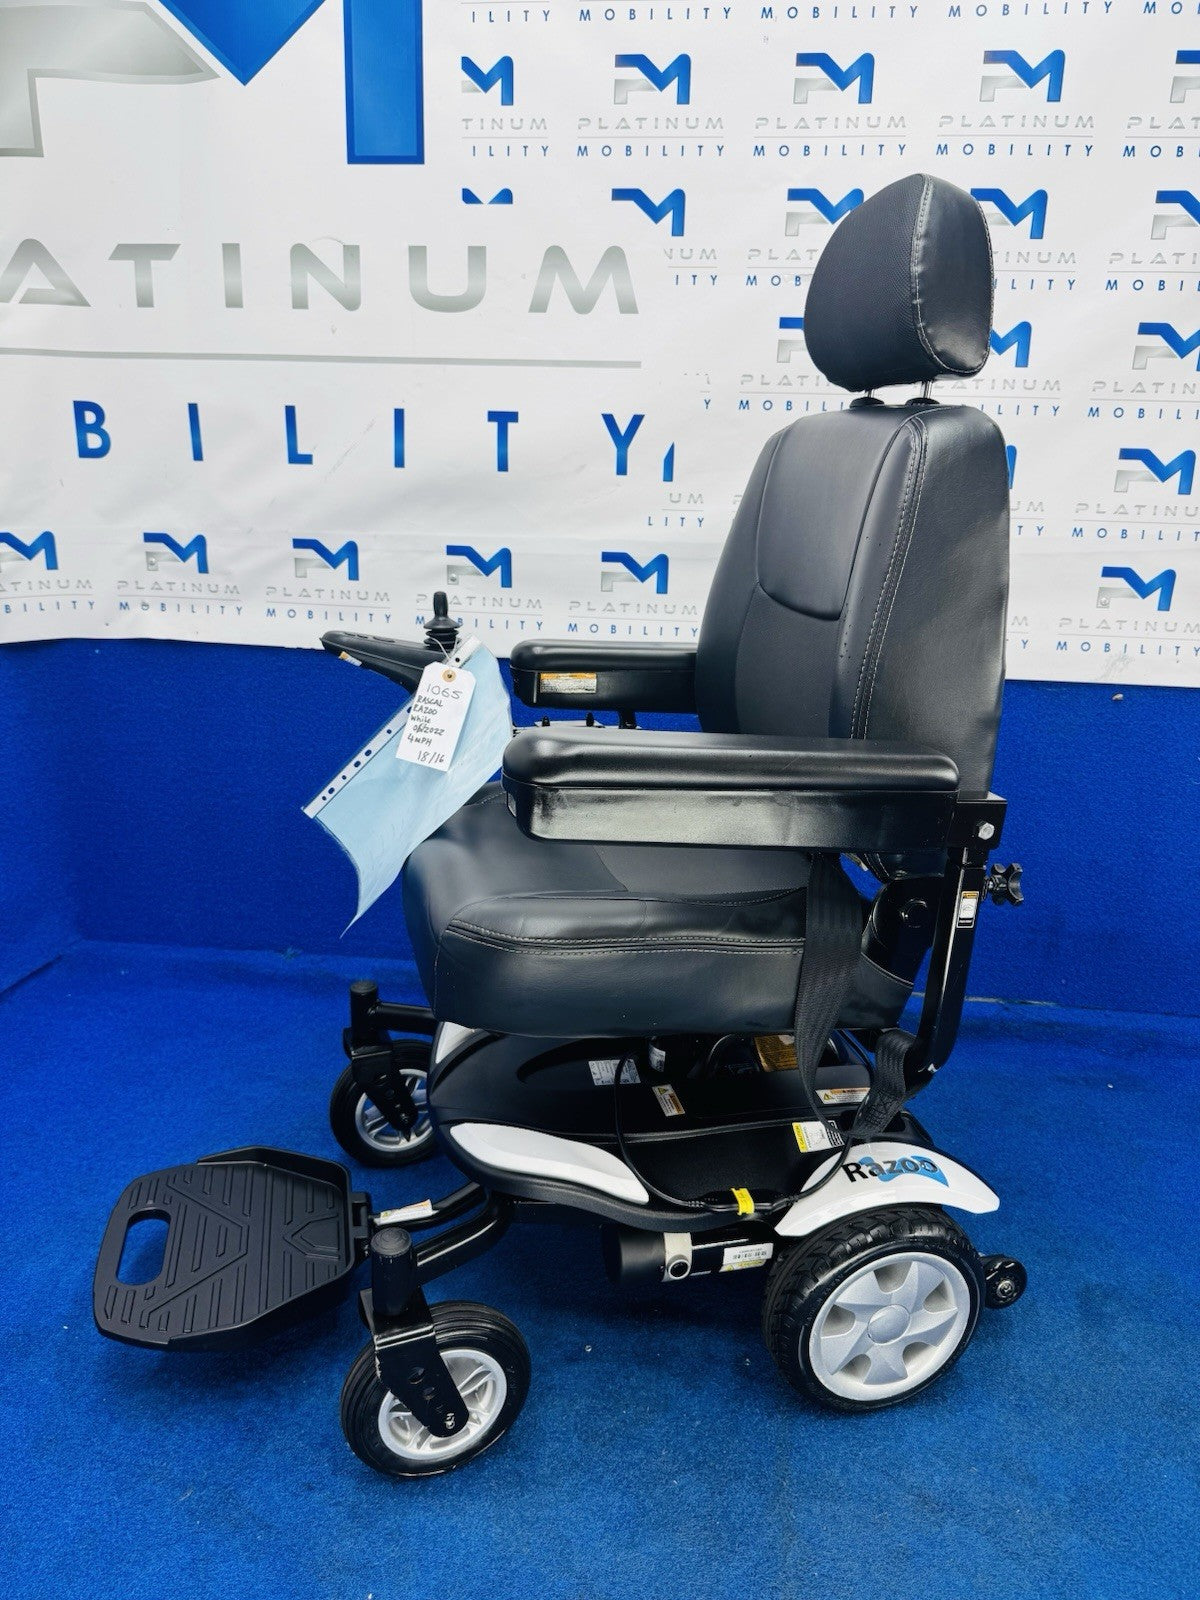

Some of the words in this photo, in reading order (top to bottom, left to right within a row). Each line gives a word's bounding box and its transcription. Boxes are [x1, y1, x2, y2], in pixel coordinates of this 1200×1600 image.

[579, 7, 731, 21] MOBILITY
[760, 5, 918, 19] MOBILITY
[948, 1, 1112, 18] MOBILITY
[1143, 1, 1200, 14] MO
[578, 117, 723, 130] PLATINUM
[756, 116, 906, 130] PLATINUM
[939, 115, 1094, 129] PLATINUM
[577, 145, 725, 157] MOBILITY
[753, 144, 906, 157] MOBILITY
[936, 144, 1093, 156] MOBILITY
[73, 400, 646, 475] BILITY
[117, 580, 241, 595] PLATINUM
[266, 586, 390, 602] PLATINUM
[118, 601, 243, 616] MOBILITY
[416, 593, 543, 609] PATINUM
[569, 600, 698, 616] PLATINUM
[266, 608, 391, 624] MOBILITY
[415, 615, 543, 631] MBILITY
[567, 622, 698, 637] MOBILITY
[1059, 617, 1200, 634] PLATINUM
[1056, 640, 1200, 657] MOBILITY
[427, 684, 463, 700] 1065
[841, 1159, 938, 1183] Razoo
